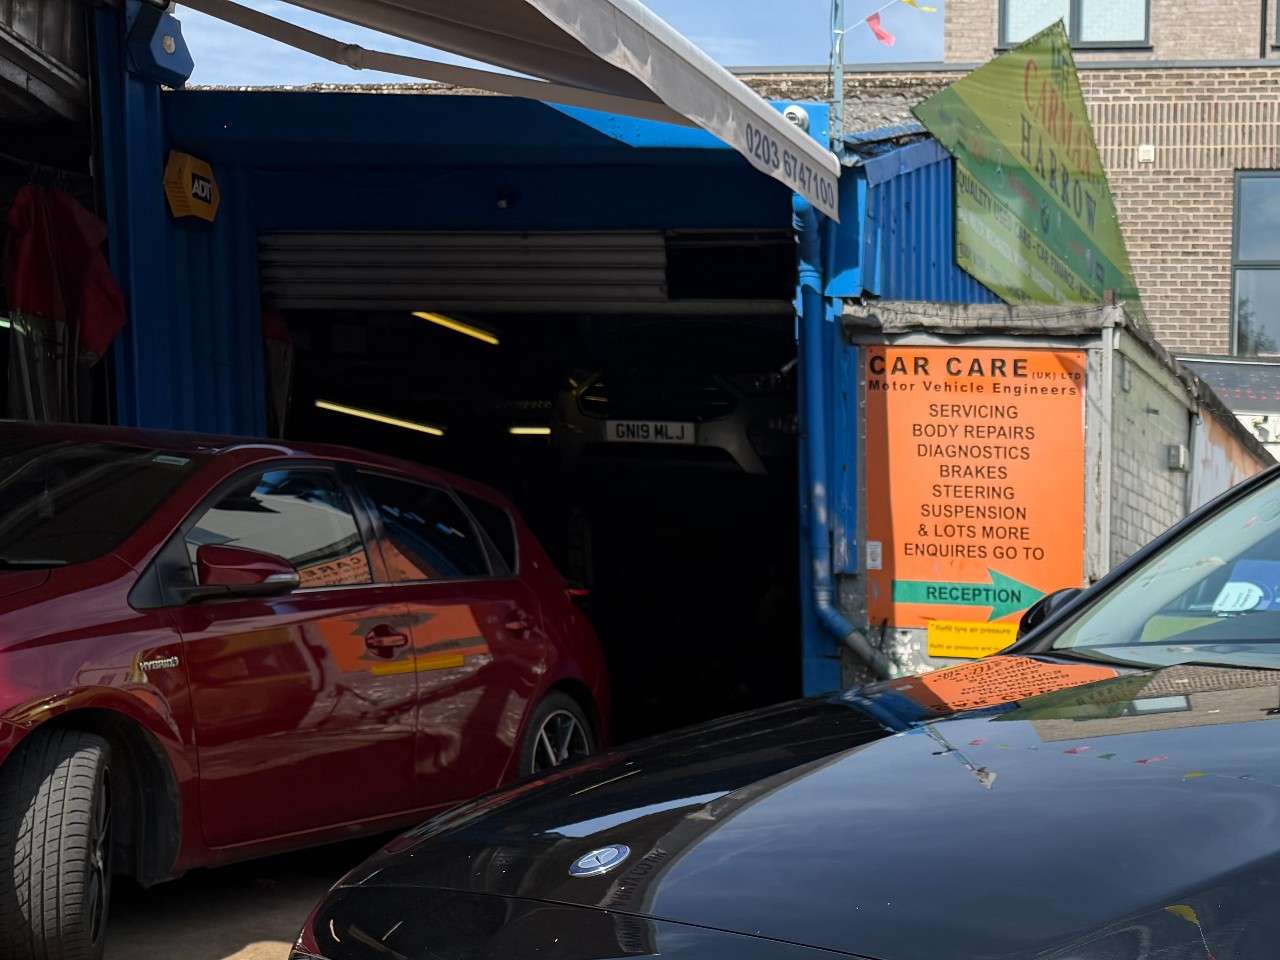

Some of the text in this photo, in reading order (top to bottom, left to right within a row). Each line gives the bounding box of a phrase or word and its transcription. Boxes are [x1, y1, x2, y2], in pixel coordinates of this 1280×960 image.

[746, 123, 834, 208] 0203 6747100
[1020, 112, 1097, 233] HARROW
[192, 176, 212, 201] ADT
[869, 355, 930, 376] CAR
[946, 358, 1029, 379] CARE
[868, 380, 1078, 397] Motor Vehicle Engineers
[929, 404, 1019, 420] SERVICING
[912, 424, 1036, 440] BODY REPAIRS
[917, 443, 1031, 460] DIAGNOSTICS
[940, 464, 1008, 480] BRAKES
[932, 484, 1015, 500] STEERING
[920, 503, 1027, 520] SUSPENSION
[918, 524, 1030, 540] & LOTS MORE
[904, 543, 1045, 560] ENQUIRES GO TO
[926, 586, 1022, 603] RECEPTION
